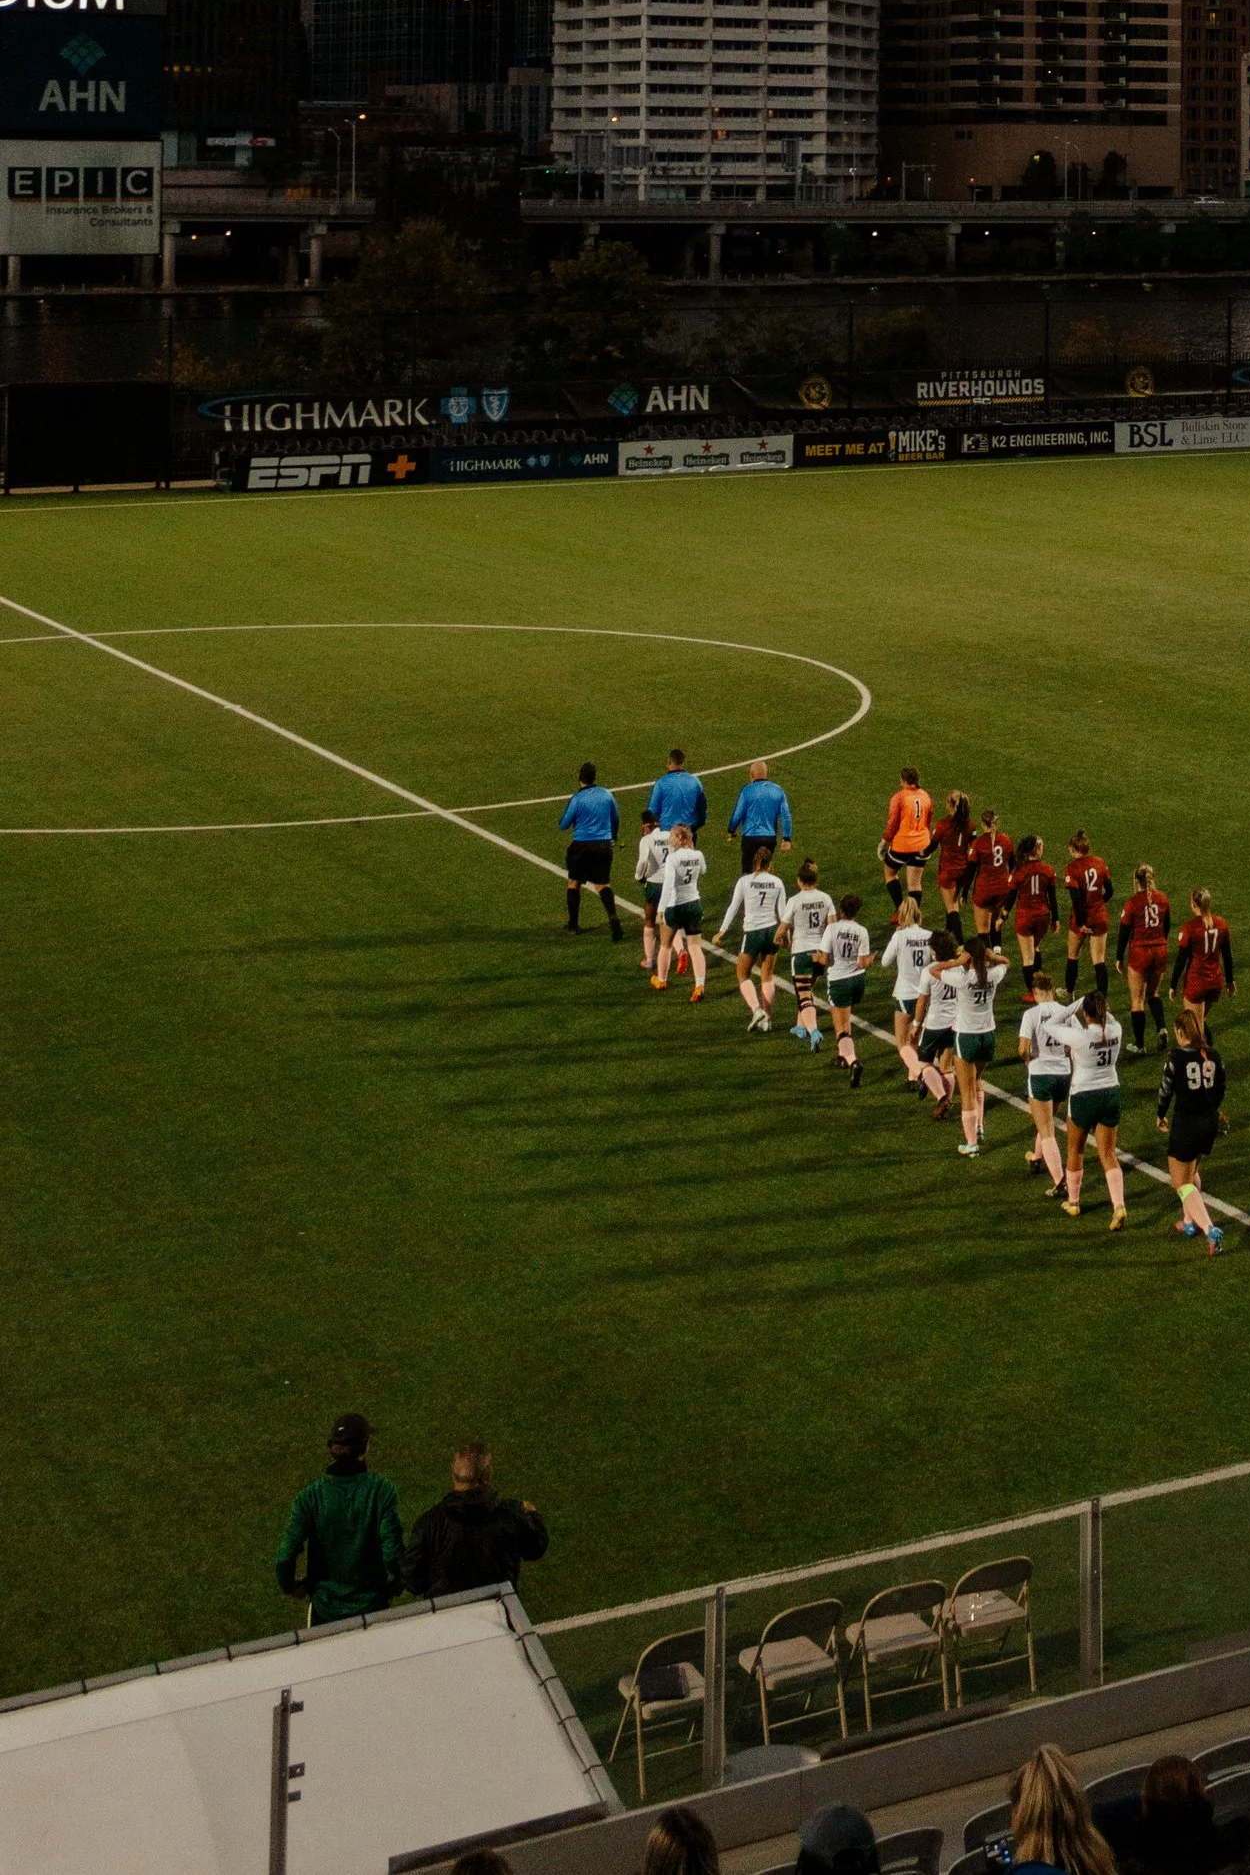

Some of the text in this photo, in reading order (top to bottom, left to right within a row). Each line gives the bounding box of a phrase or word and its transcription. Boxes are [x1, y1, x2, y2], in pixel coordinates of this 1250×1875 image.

[38, 79, 127, 113] AHN
[10, 168, 152, 196] EPIC
[46, 205, 153, 215] Insurance Brokers &
[89, 216, 153, 226] Consultants
[941, 369, 1021, 379] PITTSBURGH
[916, 378, 1045, 398] RIVERHOUNDS
[645, 384, 710, 413] AHN
[1128, 422, 1173, 448] BSL
[1181, 421, 1248, 432] Bullskin Stone
[992, 435, 1006, 448] K2
[1009, 432, 1088, 447] ENGINEERING,
[1090, 430, 1112, 443] INC.
[1181, 432, 1245, 444] & Lime LLC
[742, 453, 783, 463] Heineken
[805, 442, 886, 457] MEET ME AT
[898, 451, 946, 462] BEER BAR
[451, 456, 522, 472] HIGHMARK
[583, 453, 609, 466] AHN
[628, 458, 670, 468] Heineken
[686, 456, 727, 466] Heineken
[247, 453, 373, 489] ESPN
[914, 799, 921, 820] 1
[993, 845, 1003, 867] 8
[684, 868, 692, 884] 5
[1031, 874, 1039, 895] 11
[1085, 867, 1098, 891] 12
[759, 891, 766, 906] 7
[809, 911, 820, 928] 13
[1204, 928, 1219, 954] 17
[913, 950, 923, 967] 18
[974, 991, 987, 1004] 21
[1097, 1049, 1112, 1066] 31
[1186, 1061, 1216, 1090] 99
